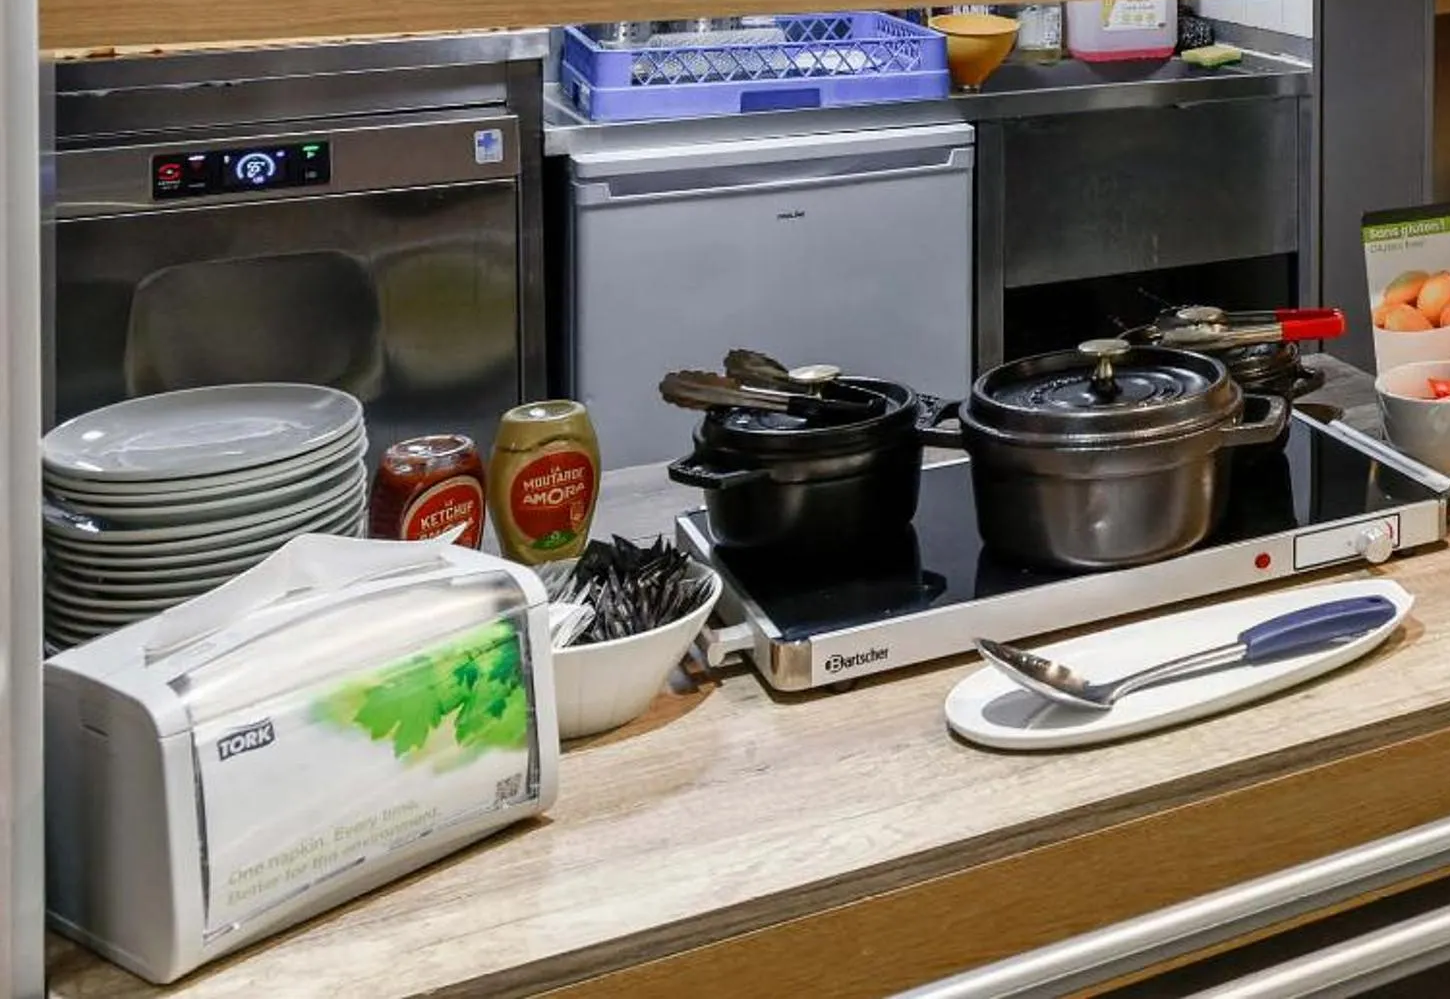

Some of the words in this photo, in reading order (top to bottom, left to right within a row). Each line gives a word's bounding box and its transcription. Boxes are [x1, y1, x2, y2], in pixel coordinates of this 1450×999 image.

[523, 467, 586, 491] MOUTARDE
[524, 482, 585, 505] AMORA
[421, 500, 474, 530] KETCHUP
[825, 648, 889, 673] Bartscher
[220, 726, 271, 757] TORK
